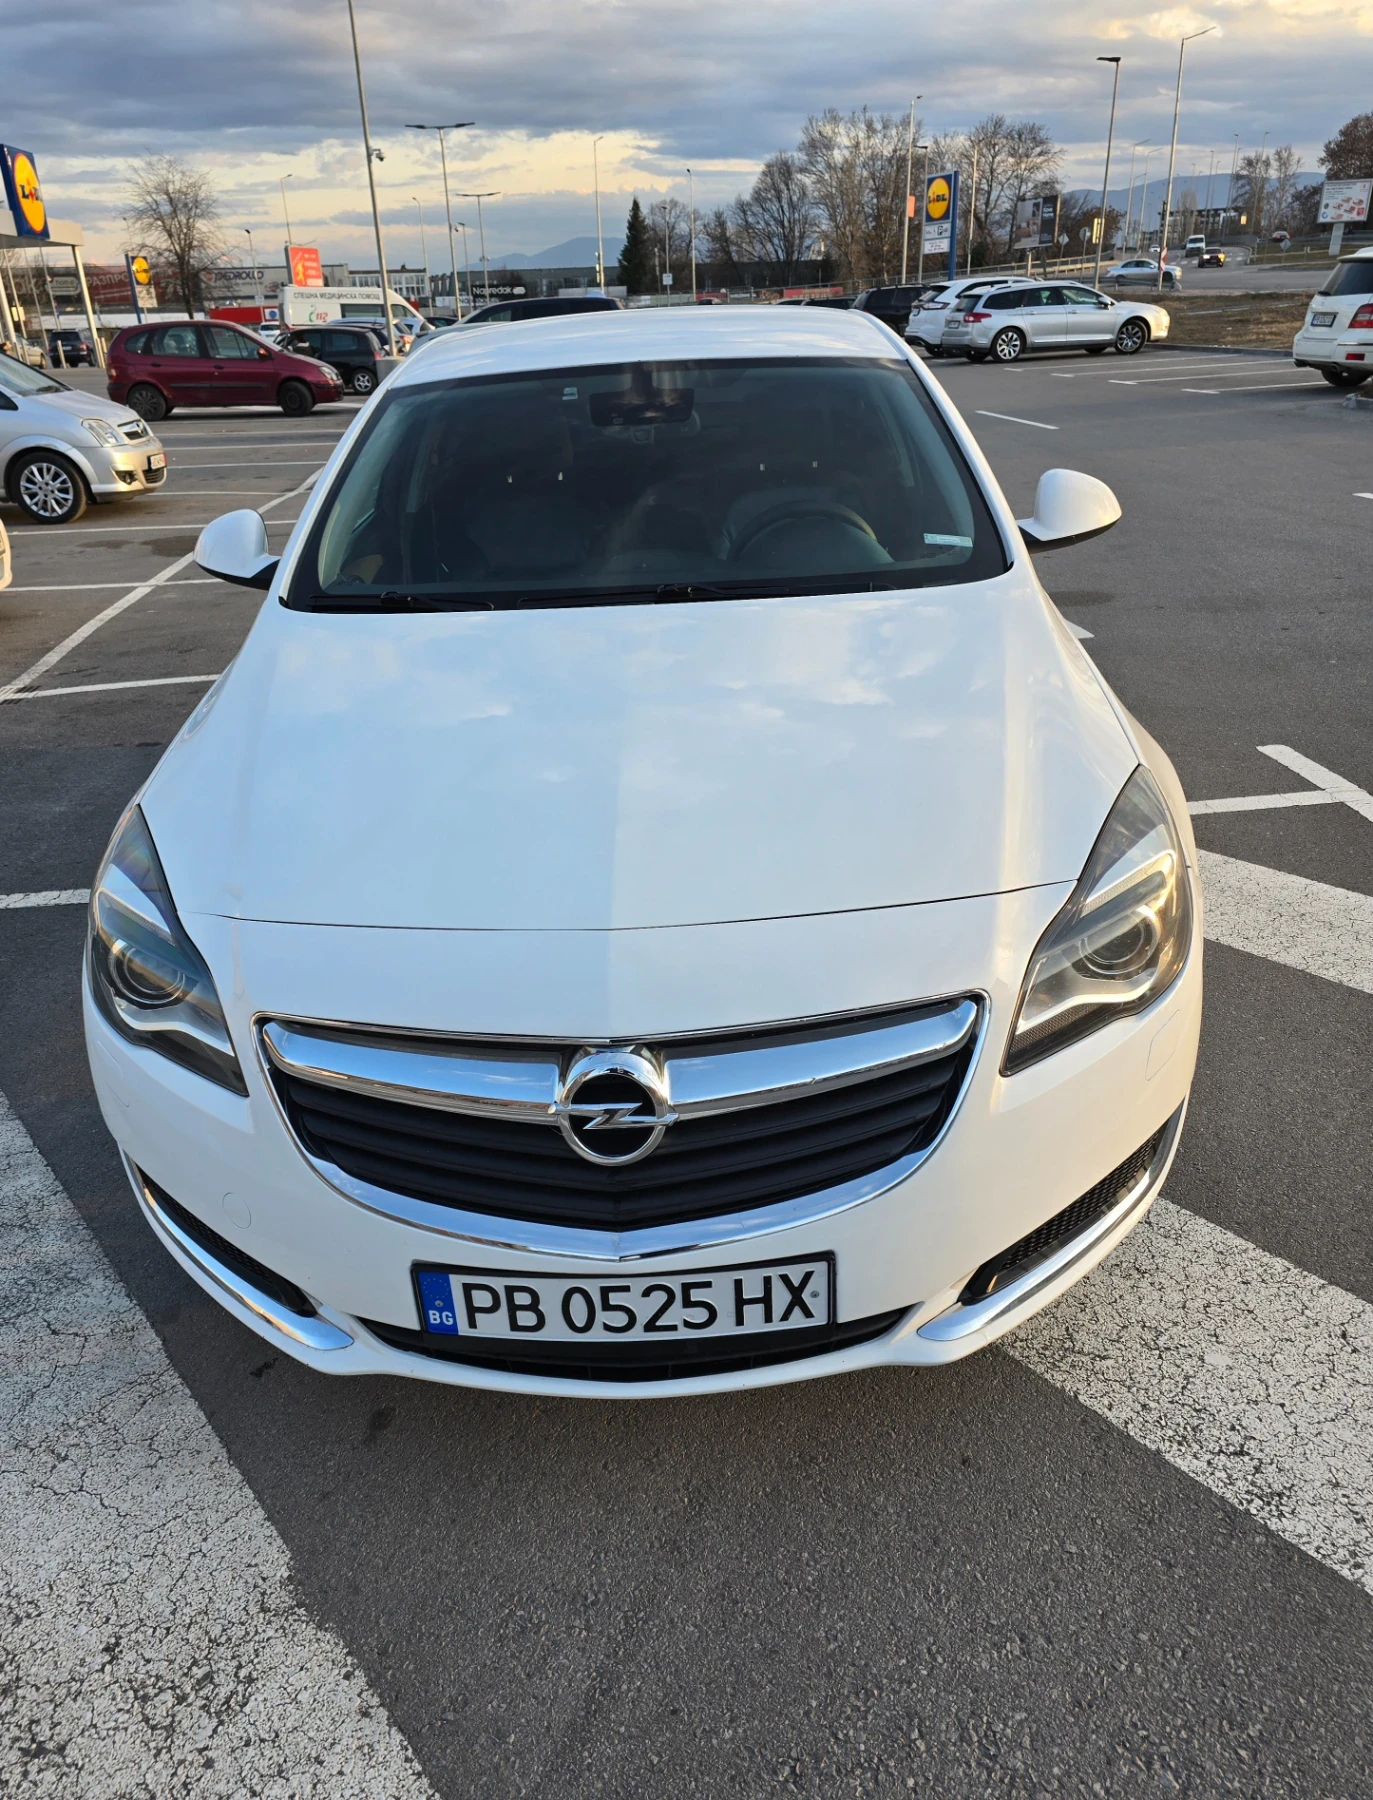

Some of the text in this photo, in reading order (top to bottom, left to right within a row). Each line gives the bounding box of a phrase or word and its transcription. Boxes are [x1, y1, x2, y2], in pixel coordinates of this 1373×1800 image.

[428, 1309, 454, 1326] BG
[461, 1270, 815, 1334] PB 0525 HX
